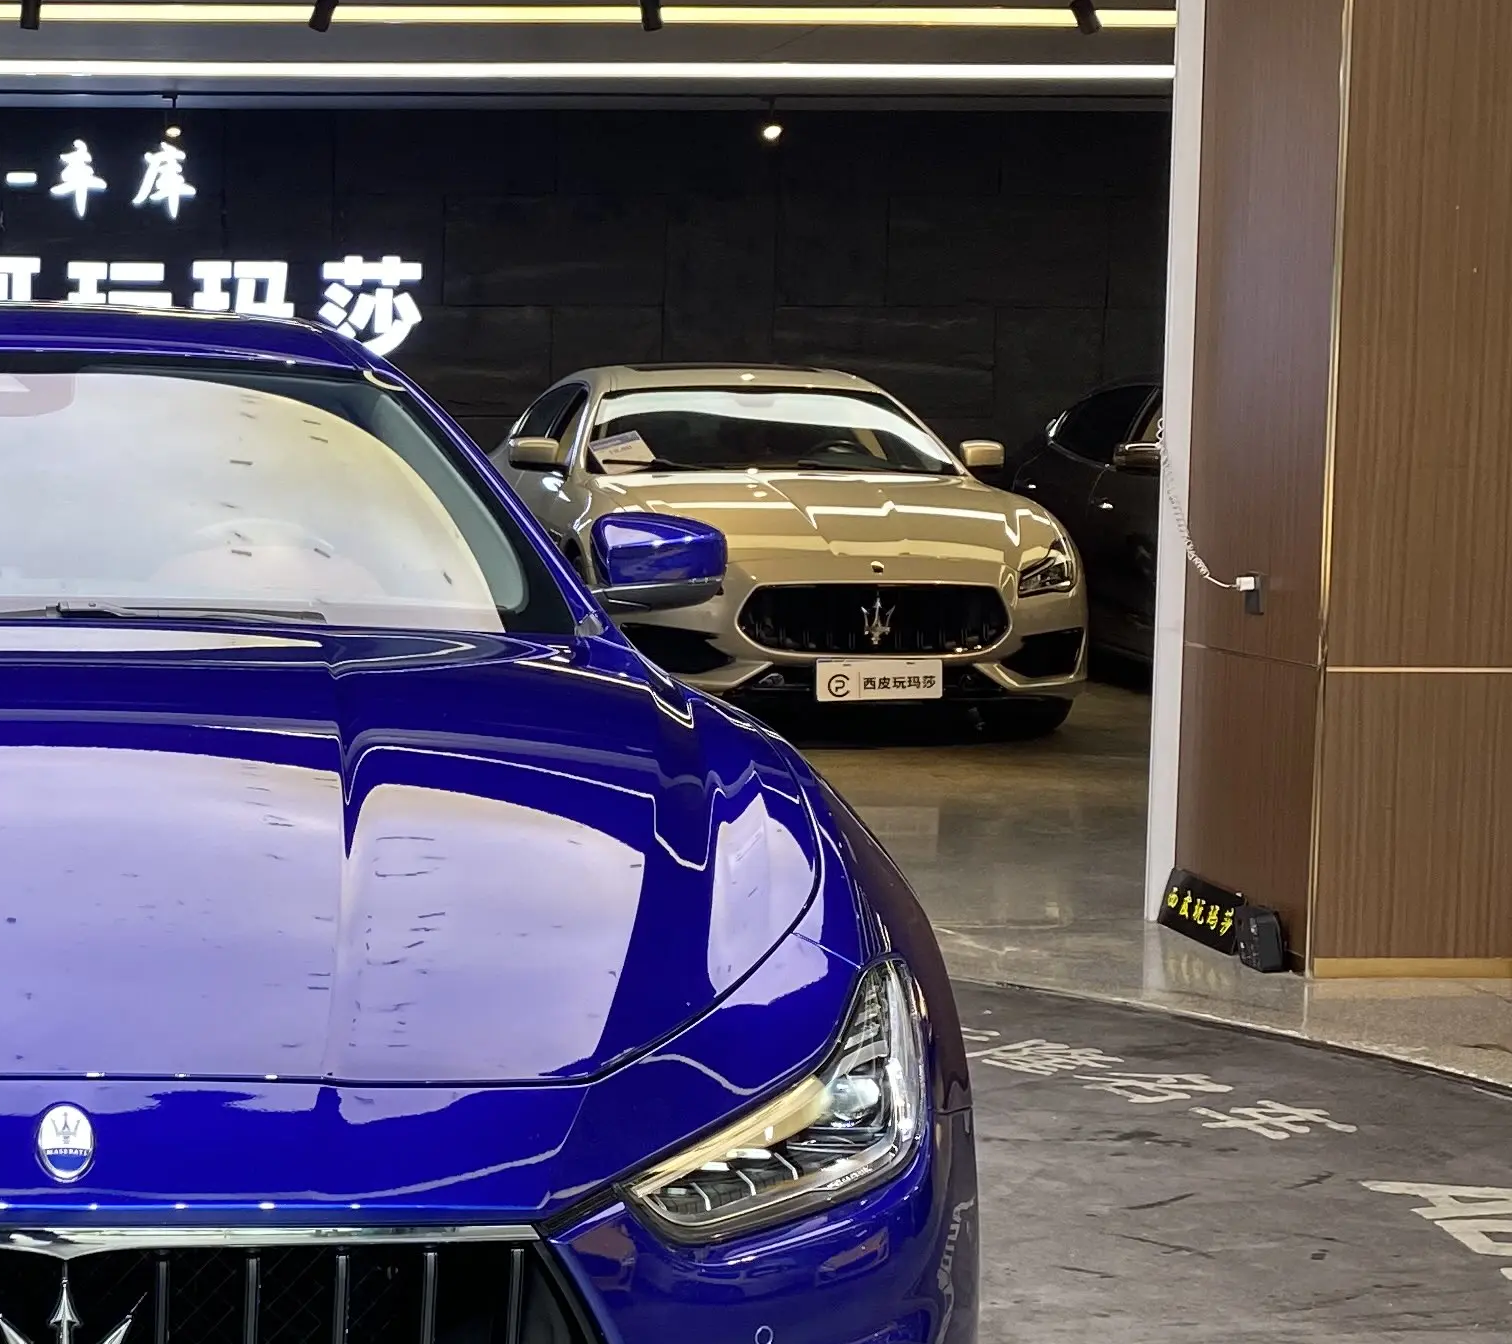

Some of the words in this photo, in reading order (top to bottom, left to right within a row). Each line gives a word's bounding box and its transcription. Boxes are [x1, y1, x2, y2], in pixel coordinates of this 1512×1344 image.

[863, 675, 936, 690] 西皮玩玛莎
